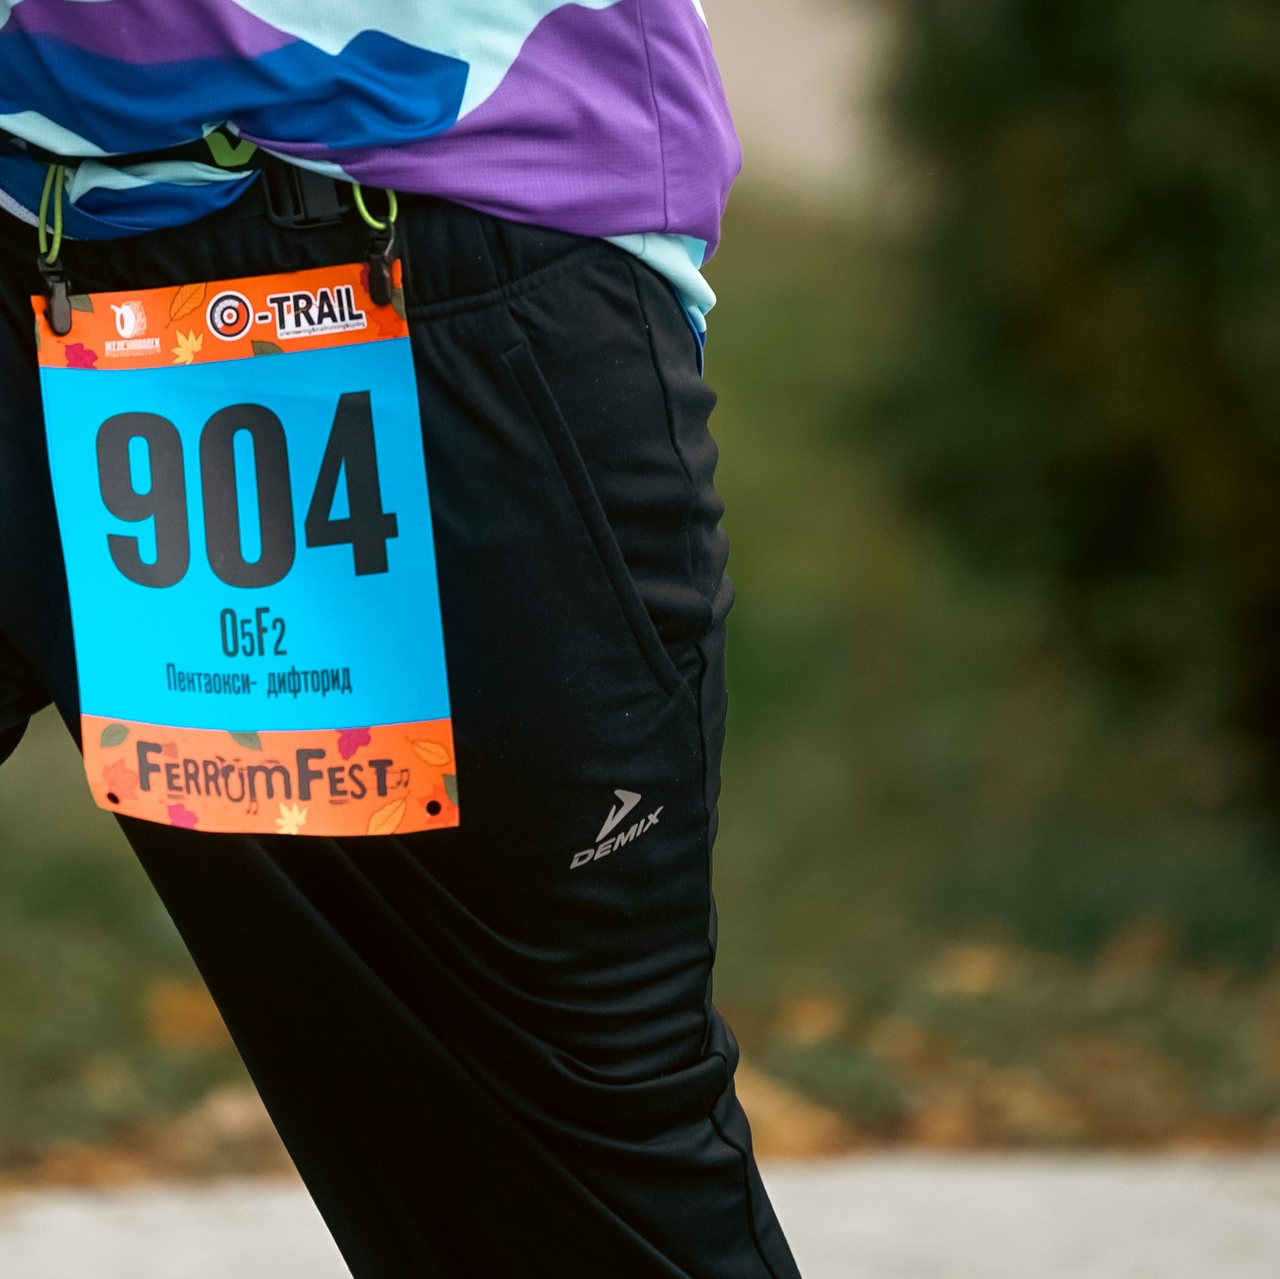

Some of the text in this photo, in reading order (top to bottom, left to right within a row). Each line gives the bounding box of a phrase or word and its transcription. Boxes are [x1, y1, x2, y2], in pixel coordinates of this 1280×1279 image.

[96, 390, 399, 589] 904
[166, 663, 352, 699] Пентаокси- дифторид
[570, 806, 664, 870] DEMIX
